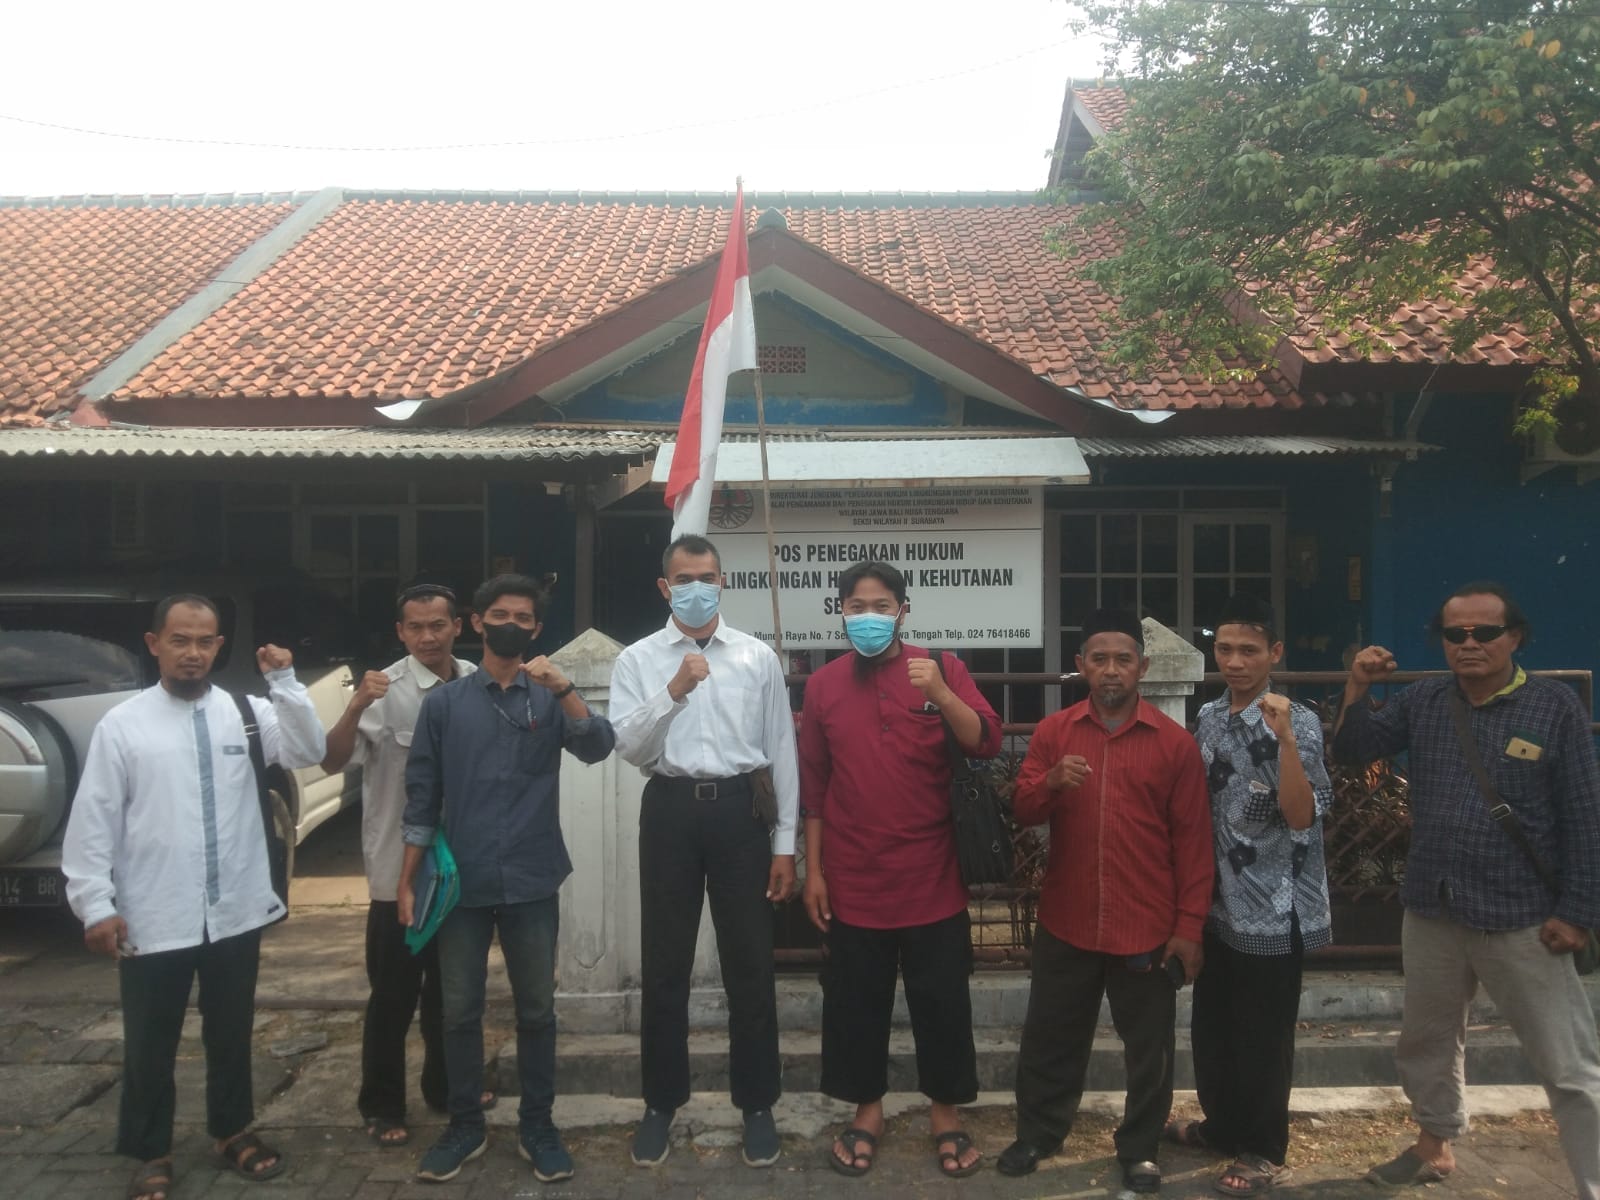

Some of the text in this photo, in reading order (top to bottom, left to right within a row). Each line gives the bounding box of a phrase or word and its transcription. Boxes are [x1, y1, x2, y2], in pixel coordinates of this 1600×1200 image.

[807, 544, 900, 562] PENEGAKAN
[905, 542, 964, 560] HUKUM
[919, 568, 1013, 587] KEHUTANAN
[785, 631, 807, 642] Raya
[809, 631, 823, 640] No.
[826, 631, 832, 640] 7
[912, 629, 943, 641] Tengah
[944, 629, 965, 641] Telp.
[967, 629, 984, 639] 024
[987, 628, 1031, 639] 76418466
